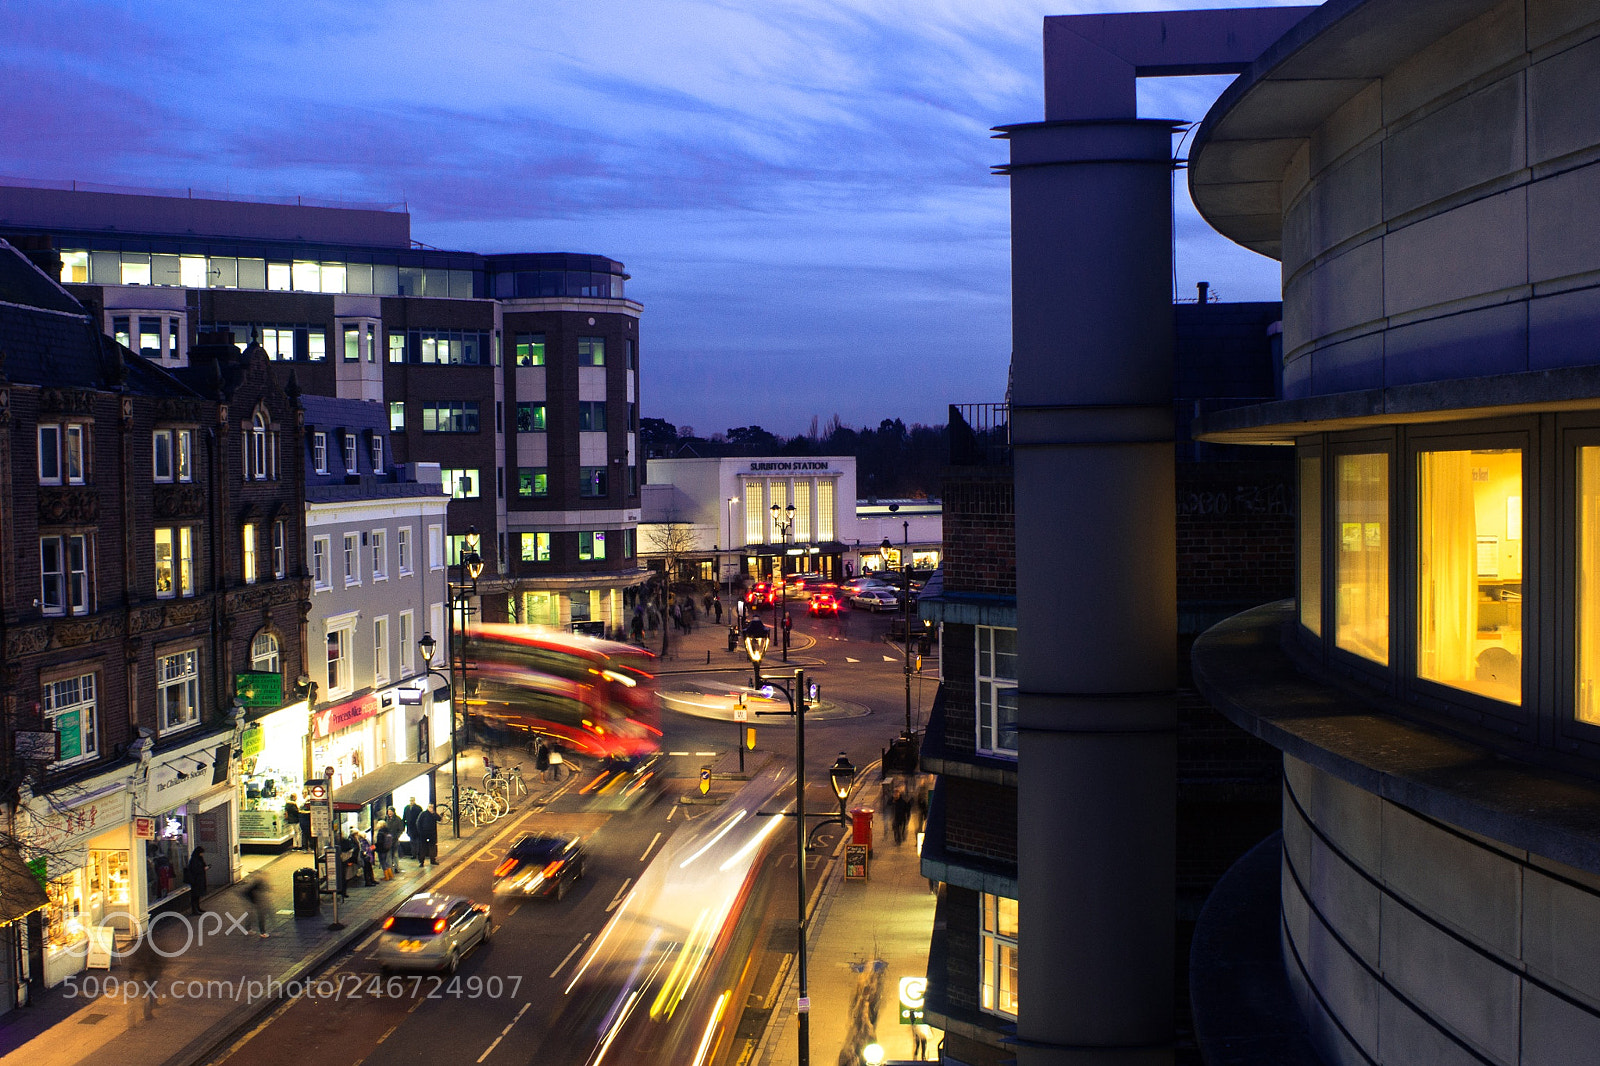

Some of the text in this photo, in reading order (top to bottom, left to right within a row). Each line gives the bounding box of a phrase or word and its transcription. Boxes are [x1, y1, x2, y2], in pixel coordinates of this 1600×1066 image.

[750, 461, 829, 471] SURBITON STATION
[333, 710, 352, 724] Princess
[351, 705, 362, 717] Alice
[156, 782, 166, 792] The
[190, 767, 208, 779] Society
